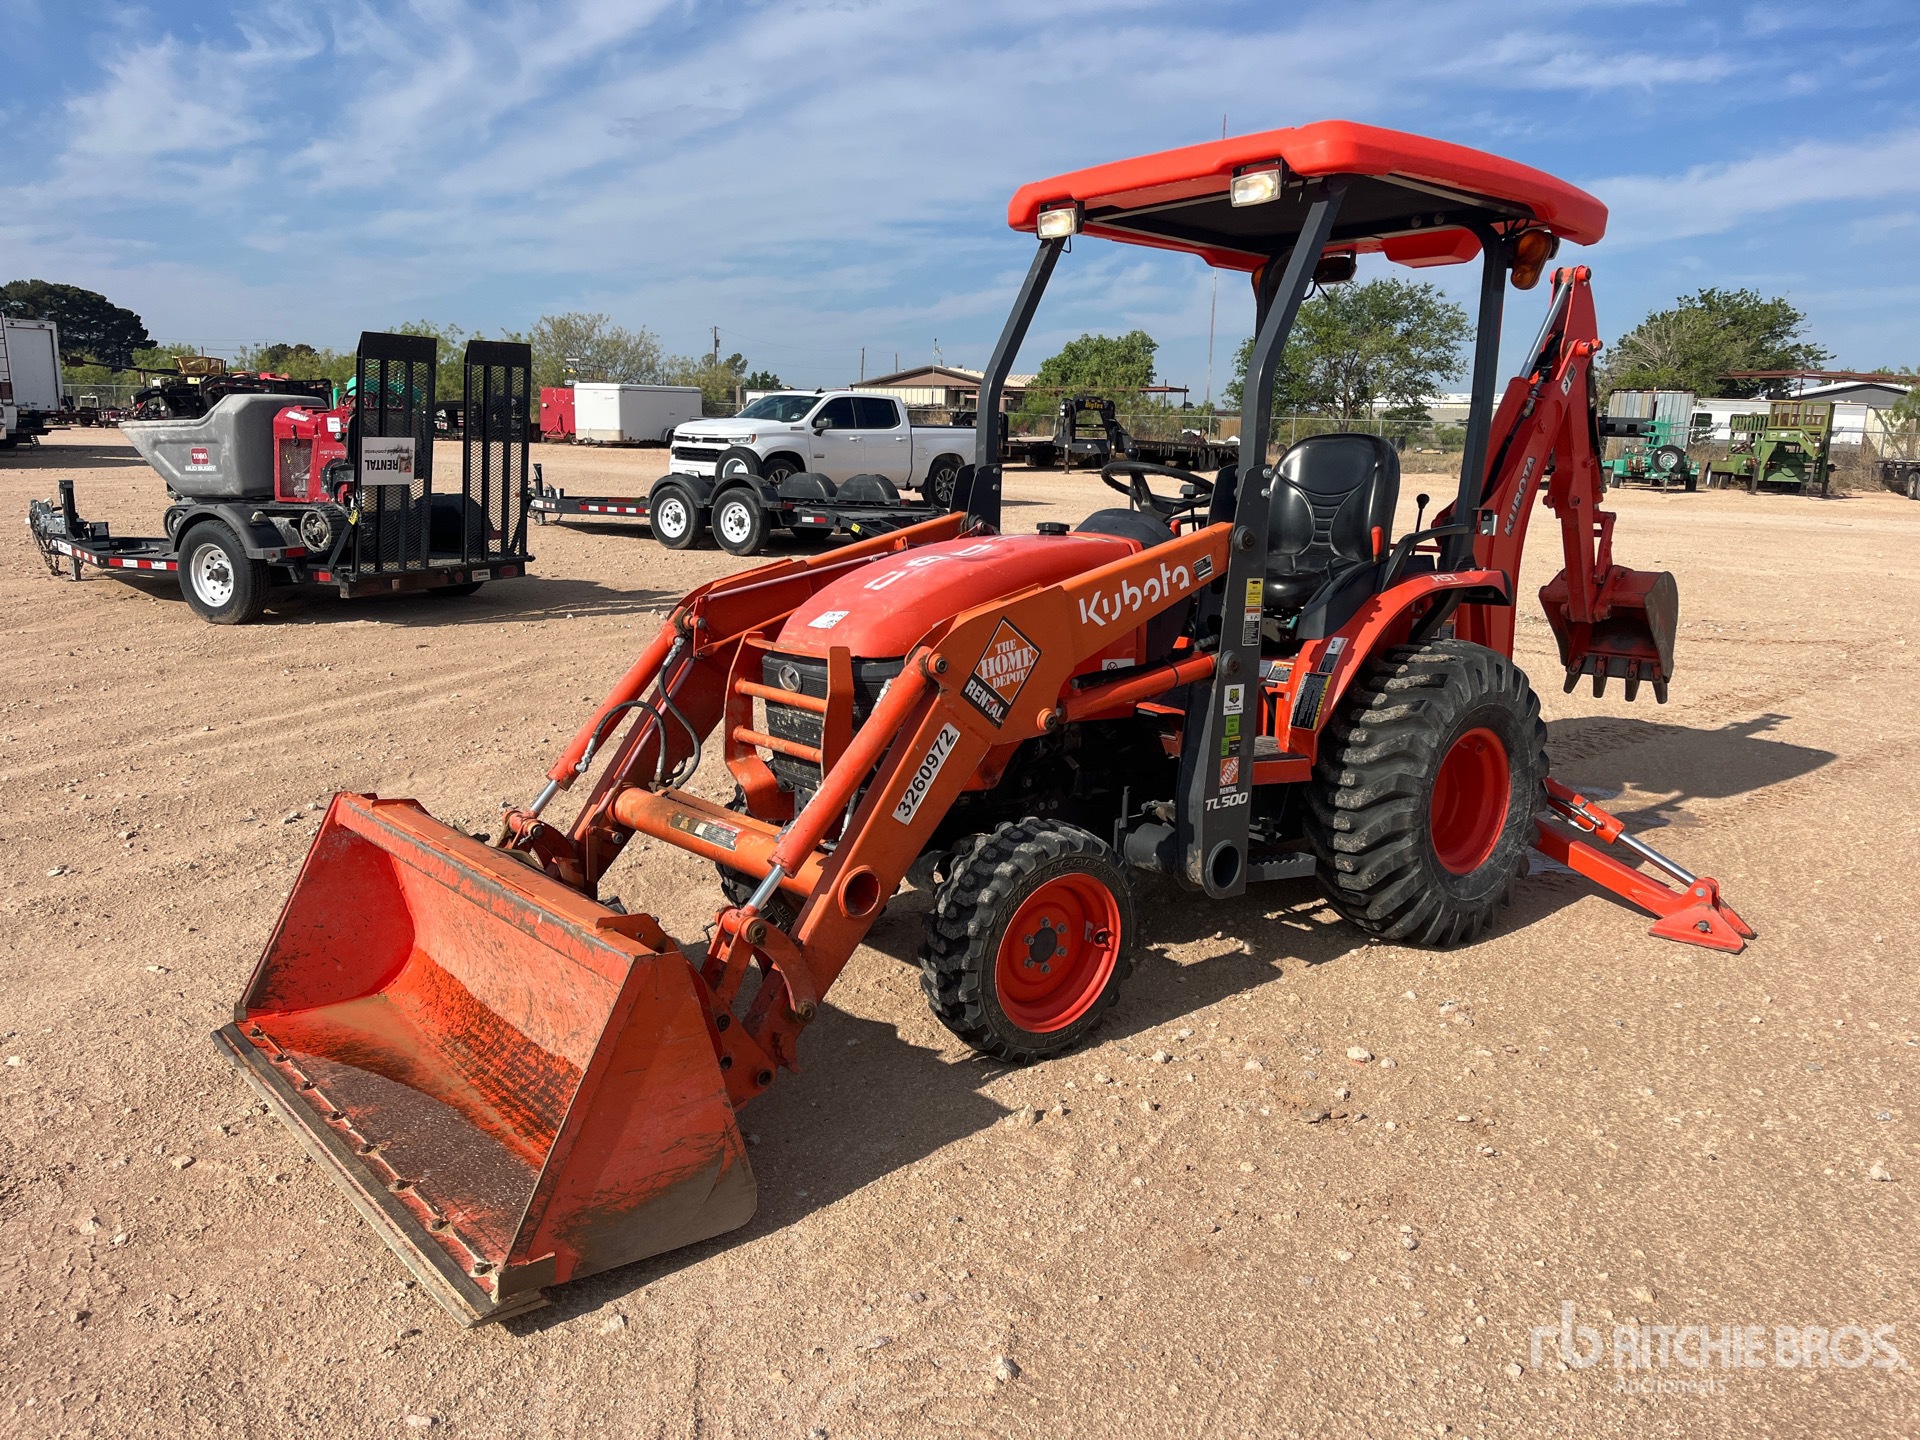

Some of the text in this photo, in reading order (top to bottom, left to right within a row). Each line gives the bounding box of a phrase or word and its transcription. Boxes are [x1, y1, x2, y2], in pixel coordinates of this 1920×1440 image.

[365, 460, 398, 470] RENTAL
[1504, 456, 1536, 537] KUBOTA
[1430, 574, 1457, 582] HST
[1079, 562, 1190, 627] Kubota
[995, 639, 1017, 654] THE
[980, 647, 1034, 680] HOME
[992, 669, 1027, 689] DEPOT
[964, 679, 1004, 723] RENTAL
[898, 729, 954, 817] 3260972
[1220, 757, 1239, 784] HOME
[1205, 791, 1249, 811] TL500
[1220, 786, 1237, 795] RENTAL
[1050, 858, 1114, 880] LOADER
